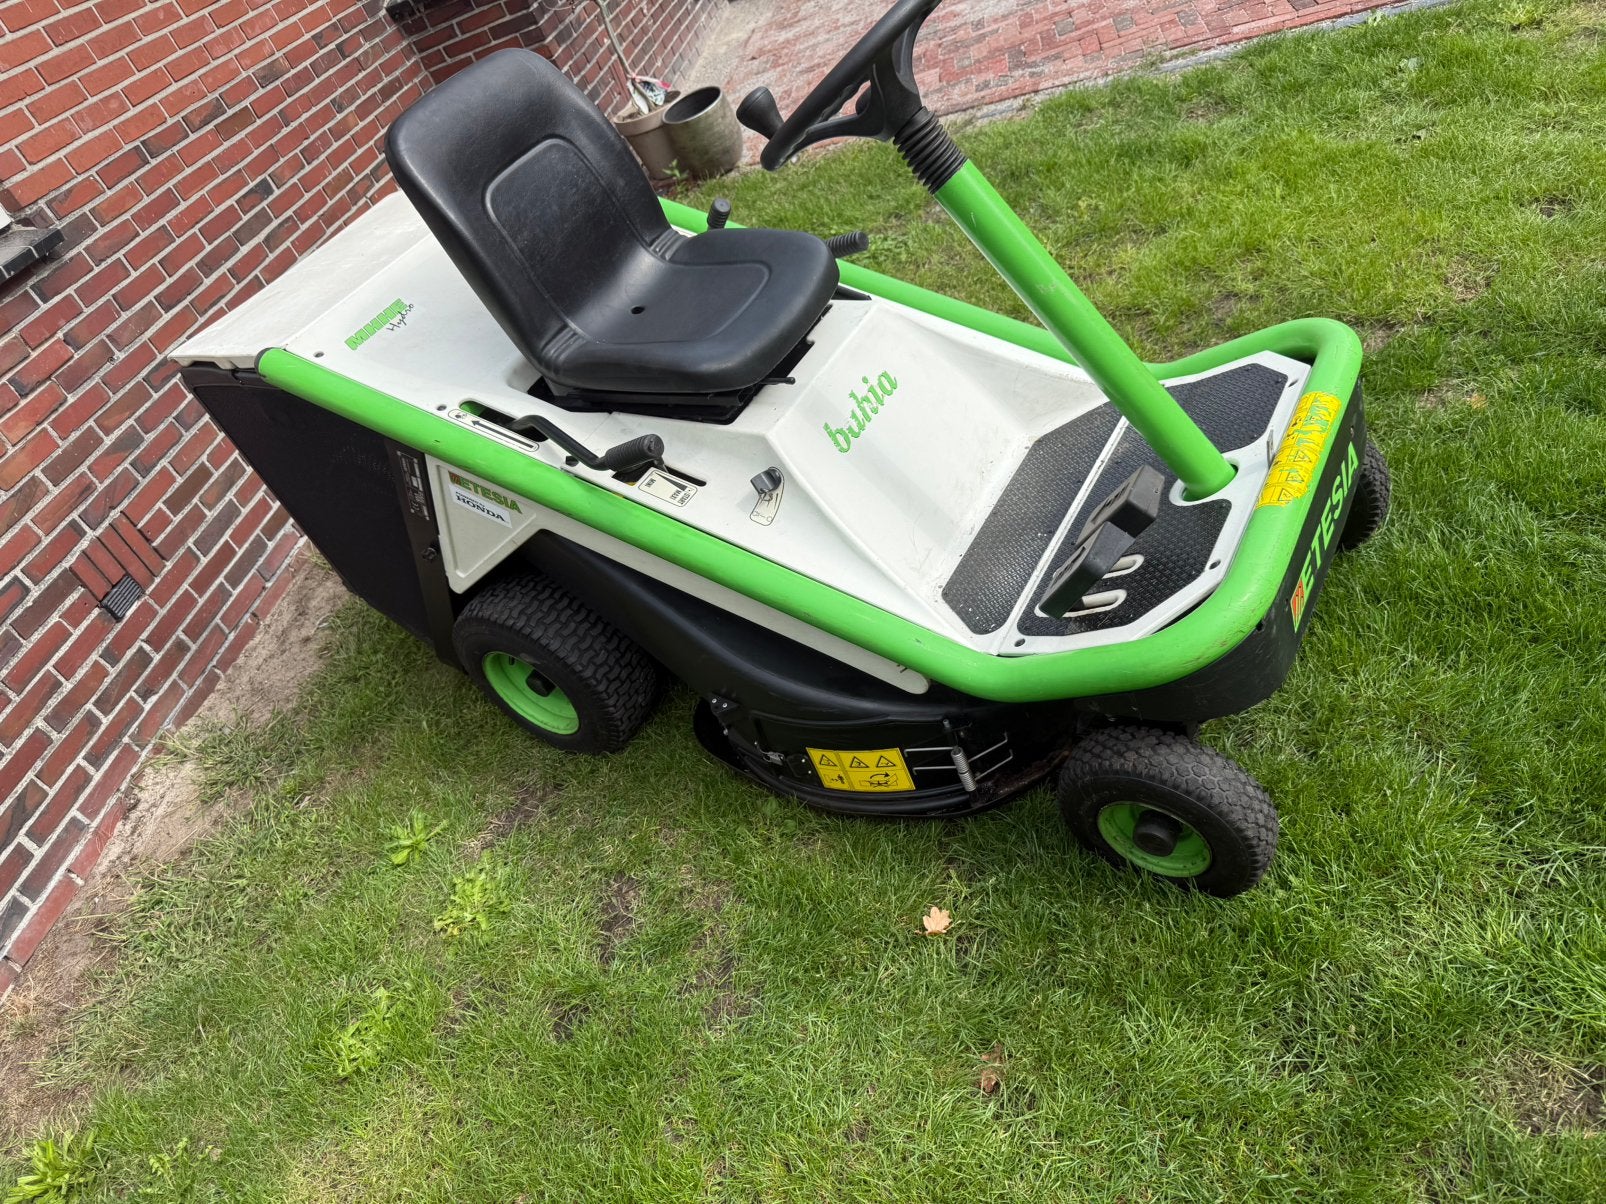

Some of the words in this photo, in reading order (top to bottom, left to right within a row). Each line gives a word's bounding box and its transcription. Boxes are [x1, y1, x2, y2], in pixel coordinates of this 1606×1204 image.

[386, 303, 414, 331] Hydro
[456, 494, 505, 522] HONDA
[459, 477, 523, 514] ETESIA
[1301, 441, 1359, 605] ETESIA
